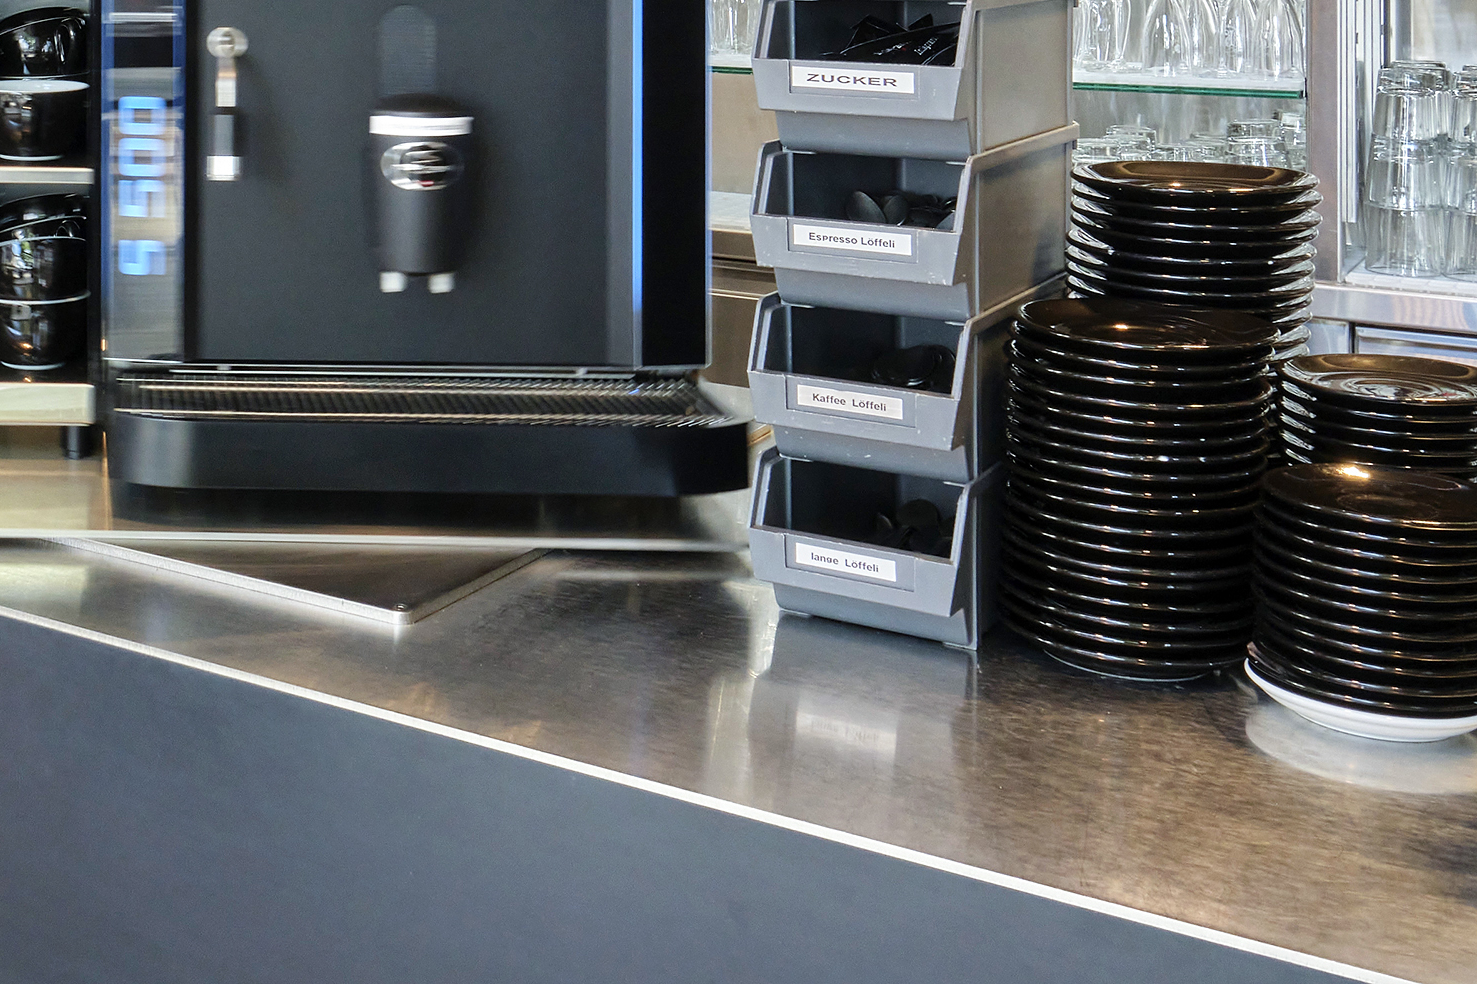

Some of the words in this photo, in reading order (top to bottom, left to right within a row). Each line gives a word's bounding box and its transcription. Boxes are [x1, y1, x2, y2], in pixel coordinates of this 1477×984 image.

[806, 73, 898, 88] ZUCKER
[809, 232, 858, 247] Espresso
[860, 235, 896, 249] Löffeli
[812, 392, 846, 406] Kaffee
[852, 398, 887, 413] Löffeli
[845, 559, 880, 573] Löffeli
